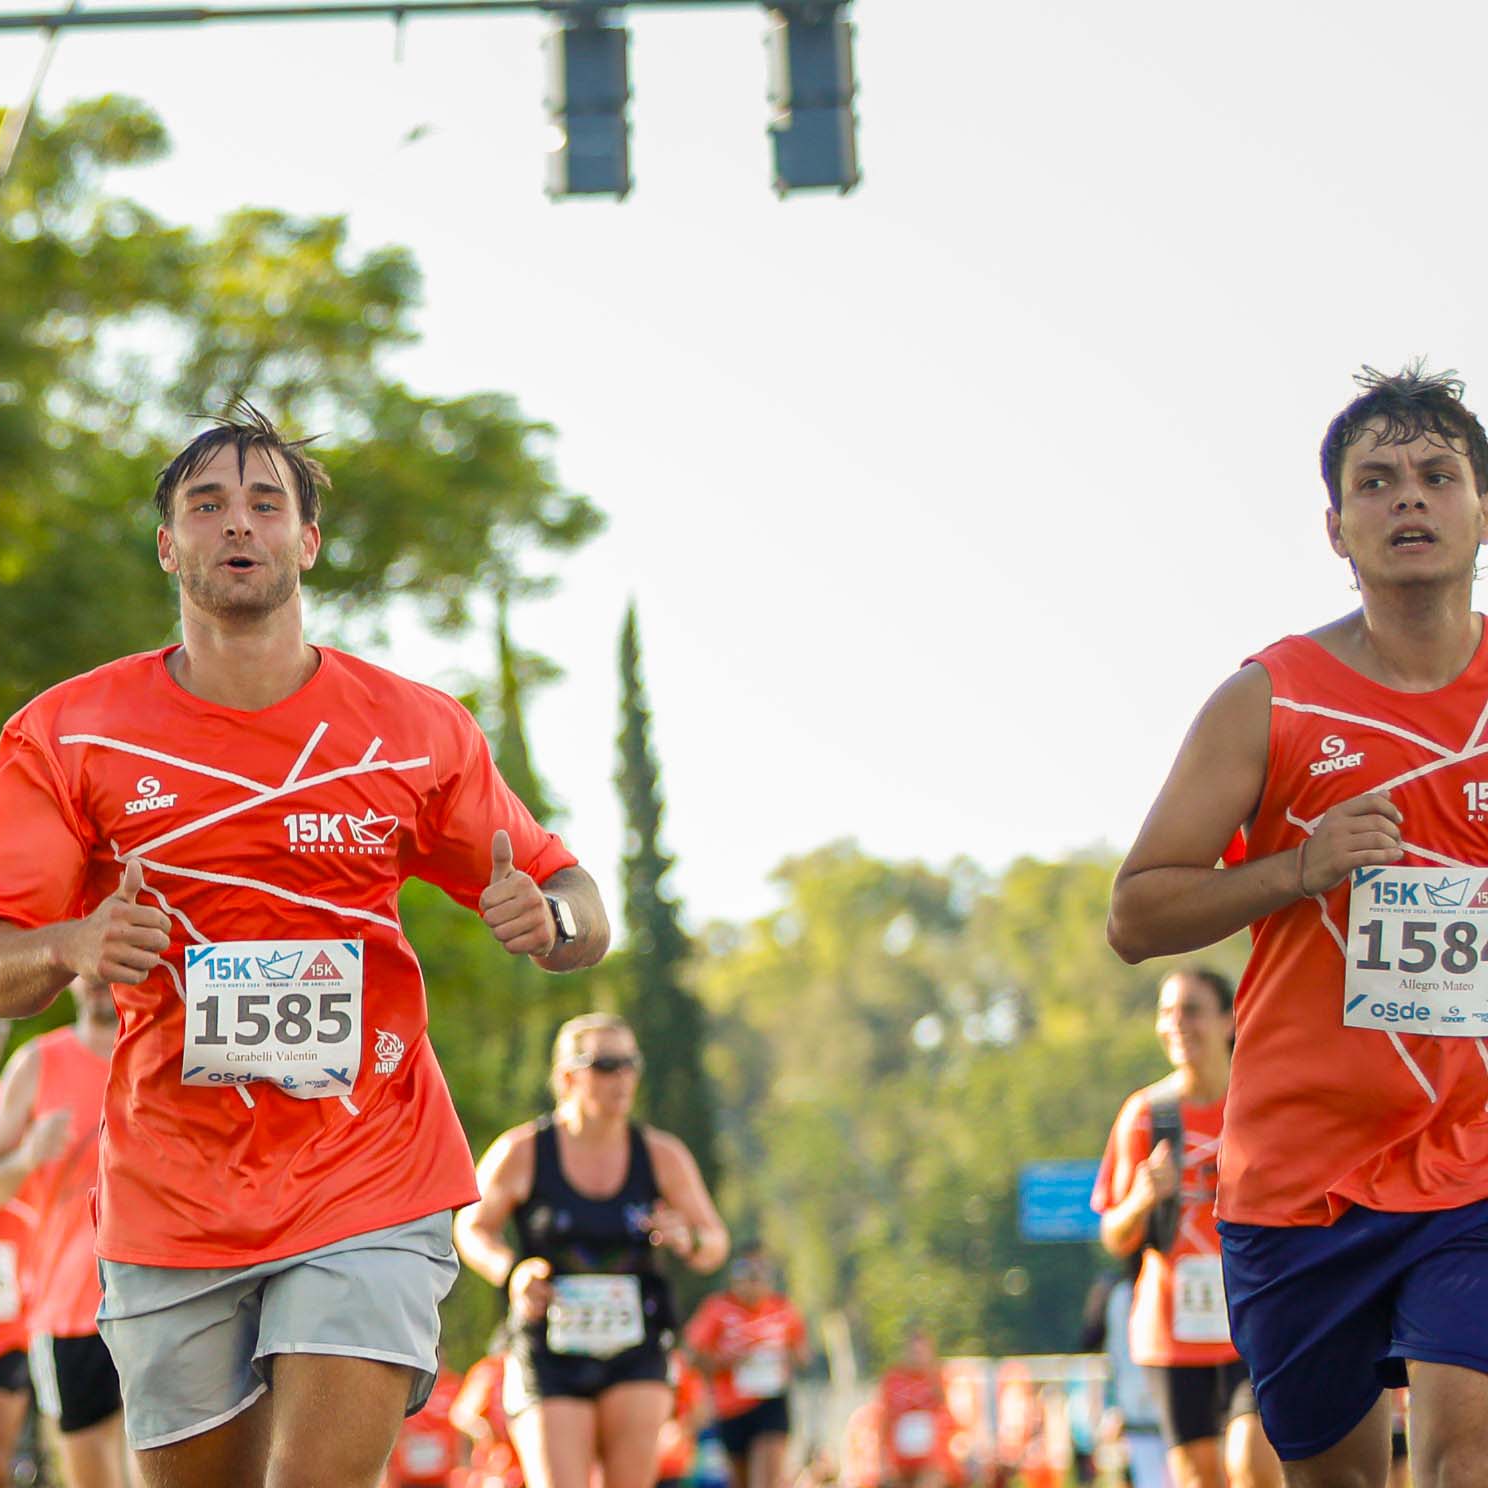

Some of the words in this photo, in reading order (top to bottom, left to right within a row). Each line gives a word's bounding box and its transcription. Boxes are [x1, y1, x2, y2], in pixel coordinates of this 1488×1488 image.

[284, 813, 344, 843] 15K
[289, 845, 344, 854] PUERTO
[1370, 881, 1420, 906] 15K
[1356, 919, 1488, 974] 158
[205, 957, 252, 980] 15K
[311, 964, 334, 977] 15K
[1399, 979, 1439, 993] Allegro
[1443, 980, 1474, 991] Mateo
[195, 993, 352, 1046] 1585
[1370, 1001, 1431, 1022] osde
[226, 1050, 273, 1062] Carabelli
[276, 1050, 318, 1062] Valentin
